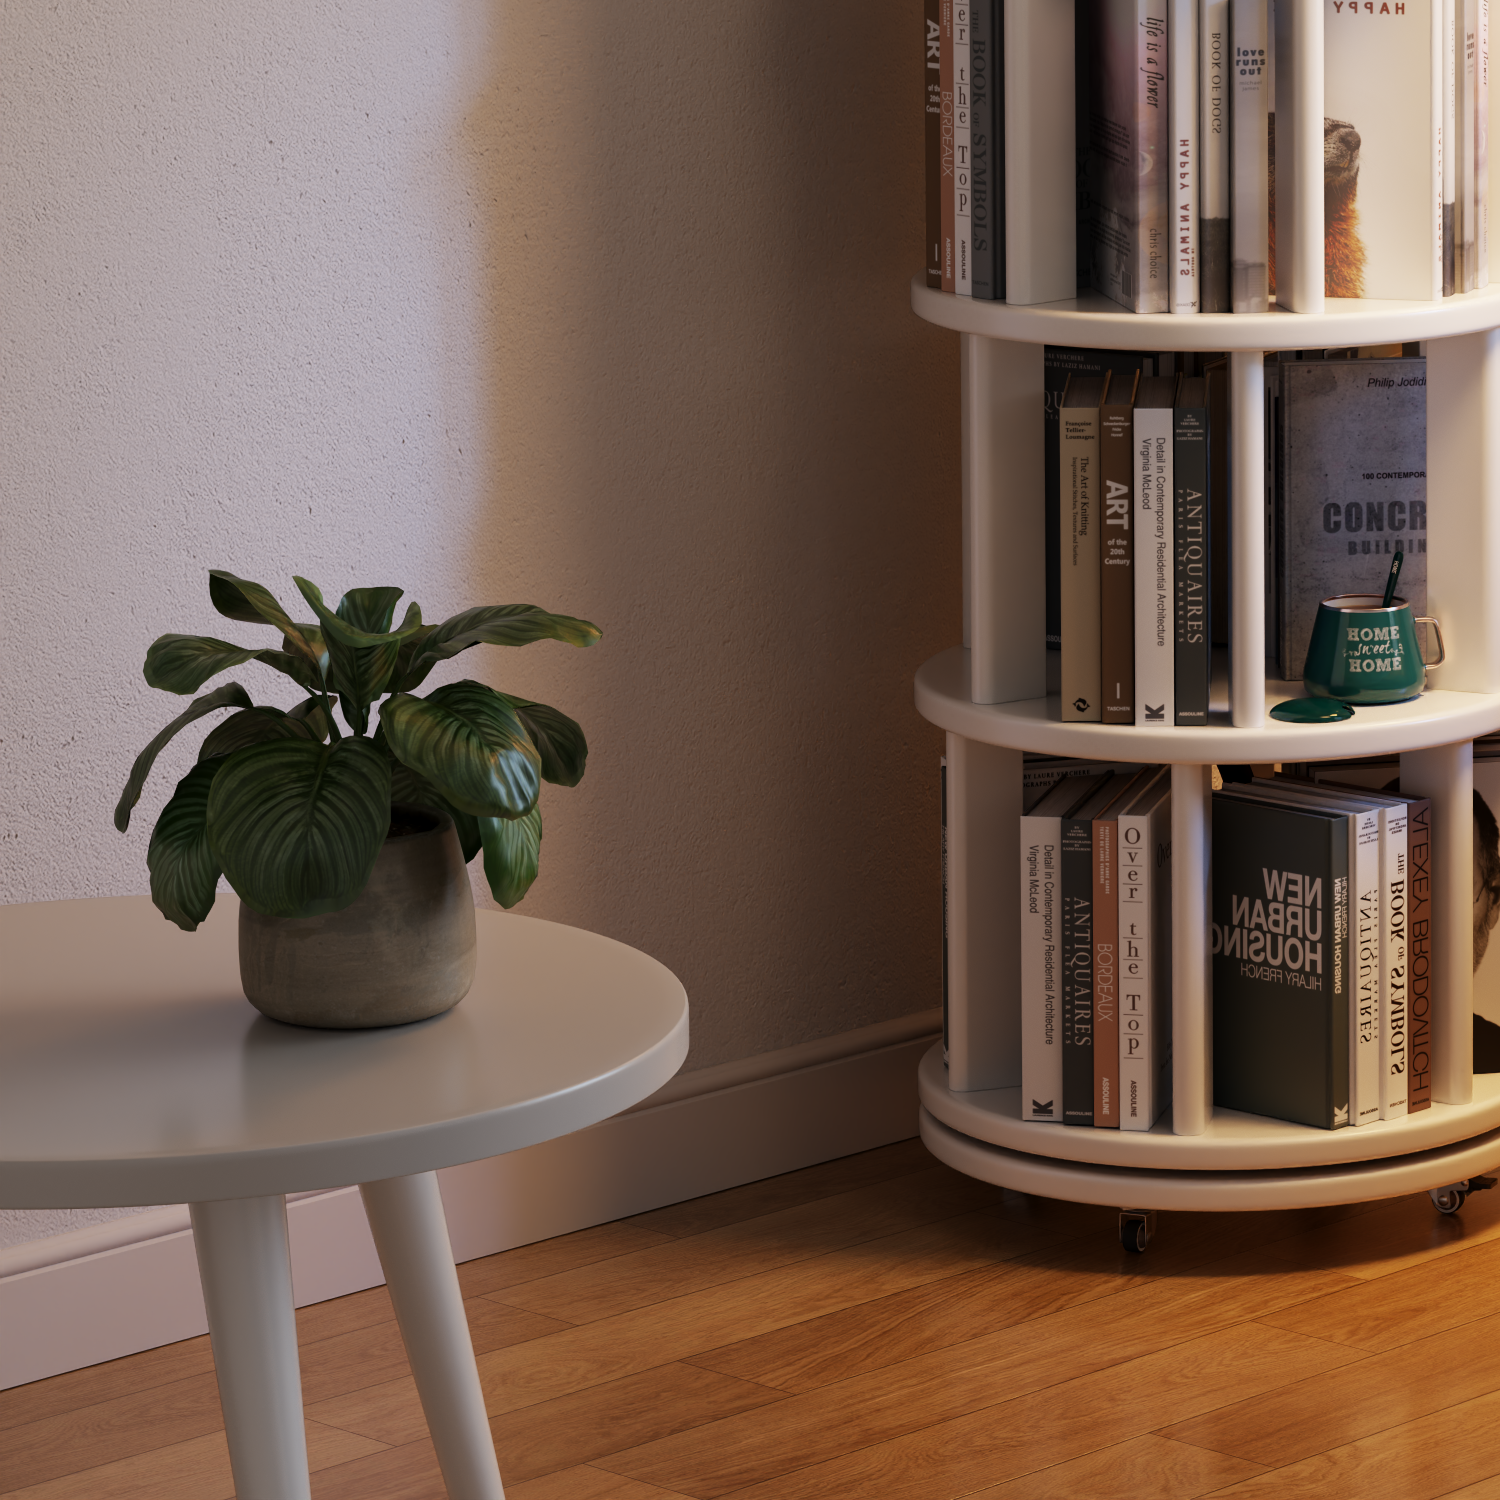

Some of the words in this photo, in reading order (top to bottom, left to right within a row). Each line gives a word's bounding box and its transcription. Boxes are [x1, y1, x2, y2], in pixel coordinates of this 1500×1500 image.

[1140, 17, 1165, 37] life
[1146, 42, 1161, 52] is
[1146, 57, 1158, 66] a
[1235, 59, 1266, 67] runs
[1236, 47, 1265, 57] love
[972, 40, 986, 107] BOOK
[1140, 67, 1165, 108] flower
[1240, 67, 1262, 76] out
[942, 92, 953, 177] BORDEAUX
[973, 112, 980, 128] OF
[973, 133, 987, 252] SYMBOLS
[1149, 228, 1161, 249] chris
[1150, 255, 1162, 279] choice
[1367, 377, 1395, 389] Philip
[1080, 456, 1090, 473] The
[1140, 438, 1152, 472] Virginia
[1156, 437, 1166, 463] Detail
[1080, 475, 1090, 489] Art
[1156, 465, 1166, 474] in
[1362, 472, 1375, 480] 100
[1376, 472, 1427, 480] CONTEMPOR
[1081, 491, 1090, 500] of
[1106, 479, 1129, 530] ART
[1142, 474, 1152, 510] McLeod
[1154, 476, 1166, 539] Contemporary
[1078, 501, 1090, 536] Knitting
[1107, 538, 1115, 546] of
[1116, 538, 1128, 546] the
[1104, 558, 1131, 566] Century
[1156, 542, 1166, 590] Residential
[1183, 488, 1203, 643] ANTIQUAIRES
[1157, 593, 1167, 647] Architecture
[1346, 626, 1400, 642] HOME
[1357, 641, 1391, 656] sweet
[1348, 657, 1402, 673] HOME
[1027, 845, 1040, 877] Virginia
[1044, 844, 1055, 869] Detail
[1124, 827, 1141, 899] Over
[1044, 871, 1055, 879] in
[1029, 879, 1040, 914] McLeod
[1042, 882, 1055, 942] Contemporary
[1126, 923, 1140, 974] the
[1044, 944, 1055, 992] Residential
[1071, 897, 1091, 1046] ANTIQUAIRES
[1097, 943, 1113, 1022] BORDEAUX
[1045, 994, 1055, 1045] Architecture
[1126, 994, 1141, 1055] Top
[1102, 1077, 1110, 1115] ASSOULINE
[1130, 1080, 1138, 1118] ASSOULINE
